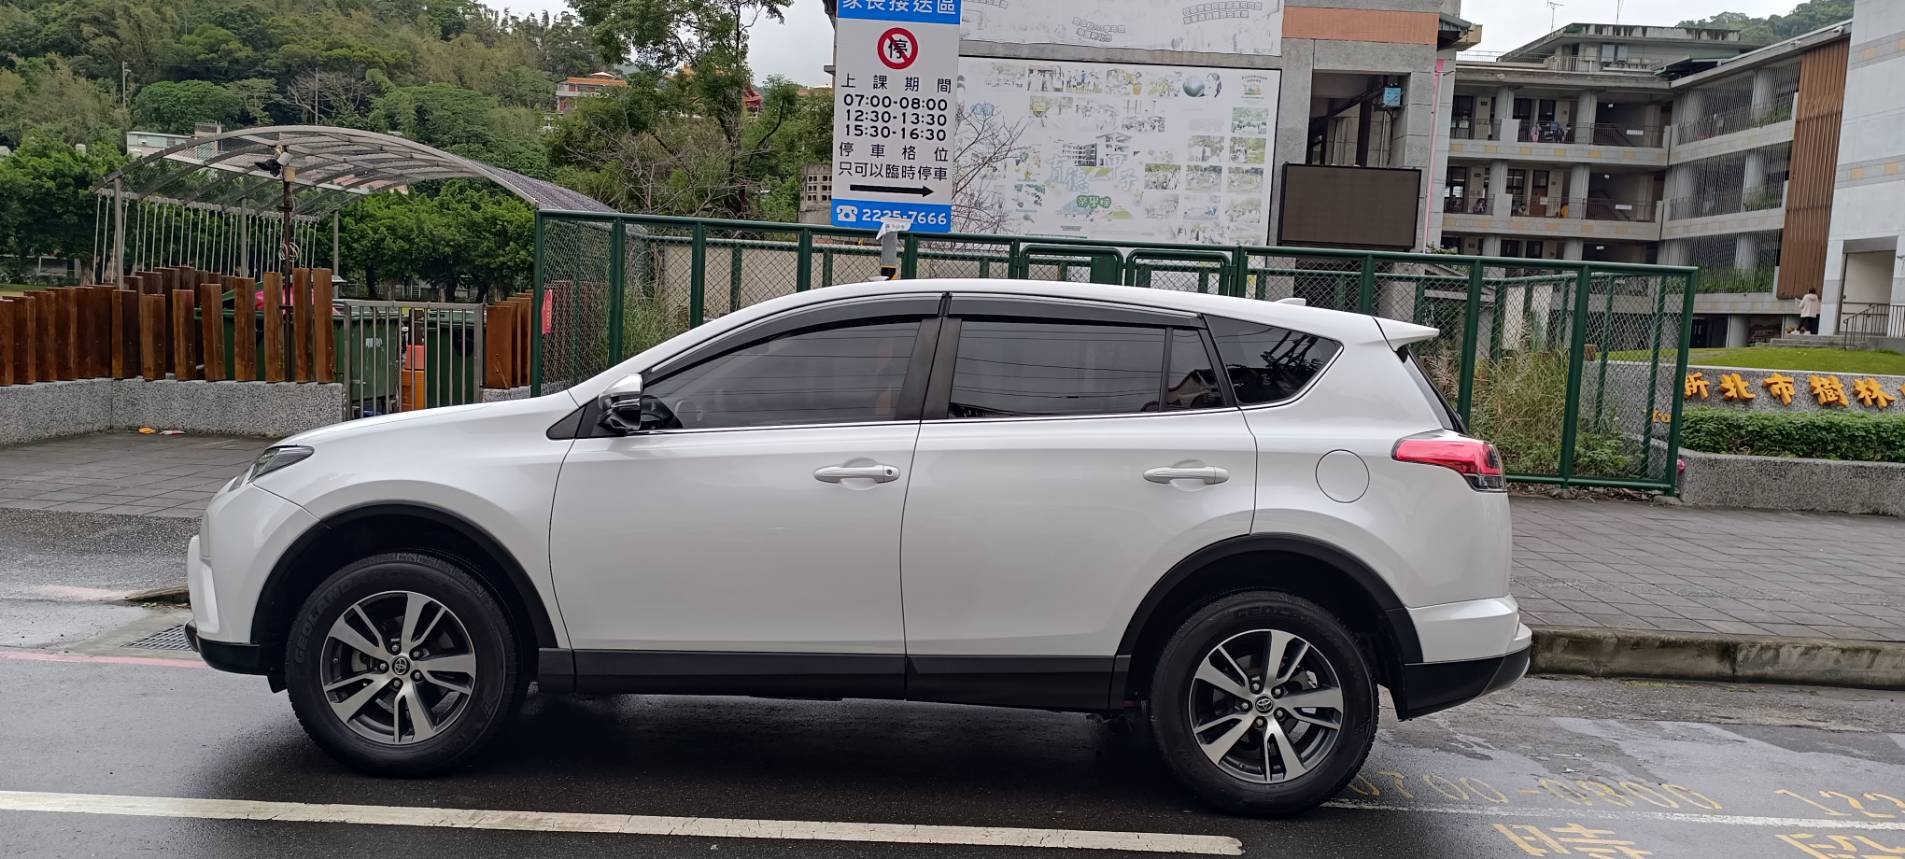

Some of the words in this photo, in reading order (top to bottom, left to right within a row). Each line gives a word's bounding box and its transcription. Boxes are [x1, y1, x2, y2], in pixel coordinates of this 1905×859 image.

[888, 38, 908, 58] 停
[841, 73, 951, 94] 上課期間
[844, 93, 948, 111] 07:00-08:00
[846, 109, 947, 126] 12:30-13:30
[845, 124, 946, 141] 15:30-16:30
[839, 141, 948, 162] 停車格位
[839, 161, 947, 181] 只可以臨時停車
[862, 208, 947, 225] 2225-7666
[1685, 371, 1905, 409] 新北市樹林
